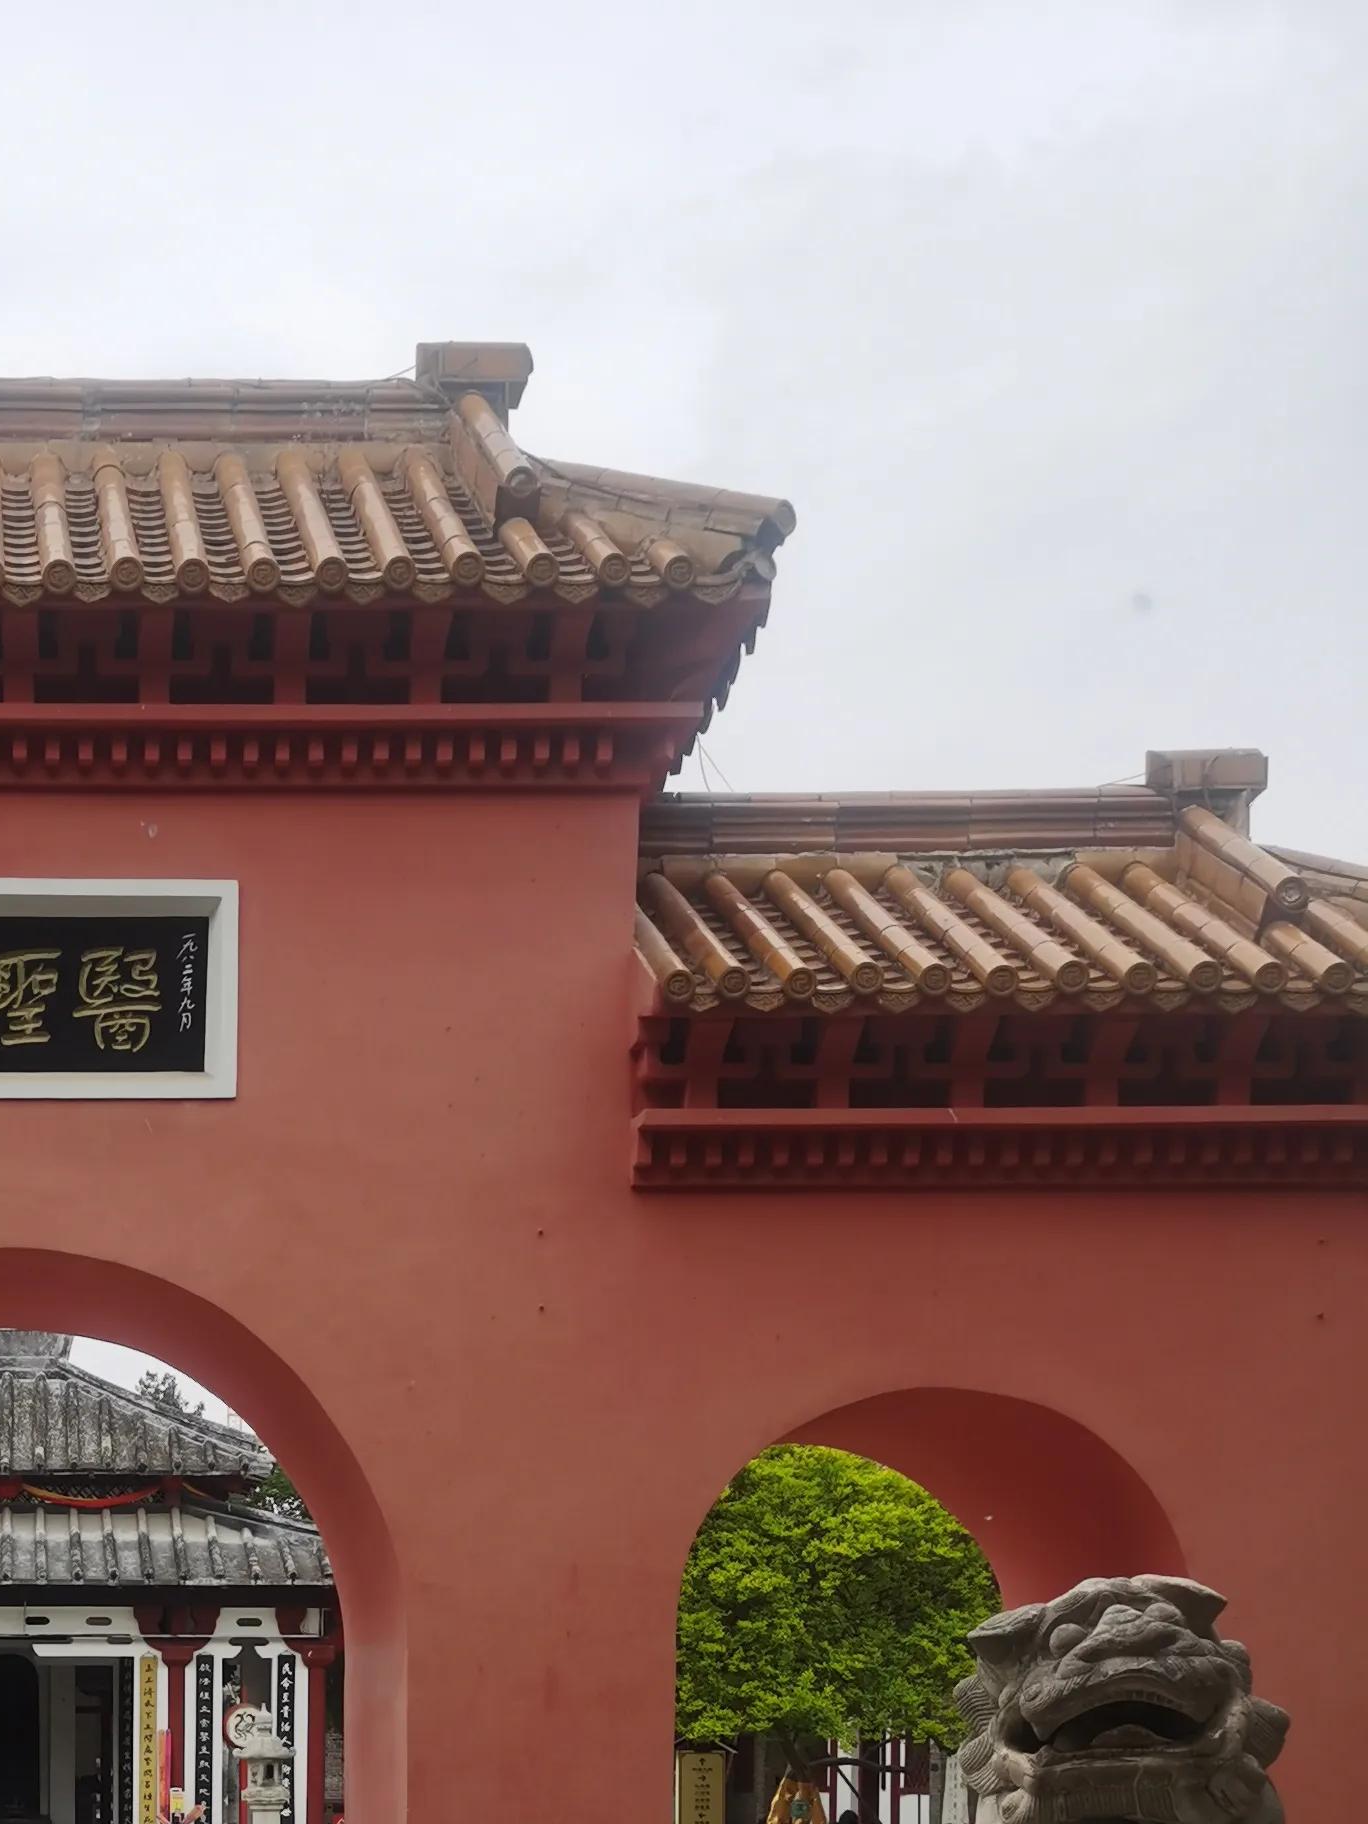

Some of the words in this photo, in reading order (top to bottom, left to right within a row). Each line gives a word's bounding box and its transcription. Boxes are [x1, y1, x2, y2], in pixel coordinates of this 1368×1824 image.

[176, 932, 199, 1033] 一九八二年九月
